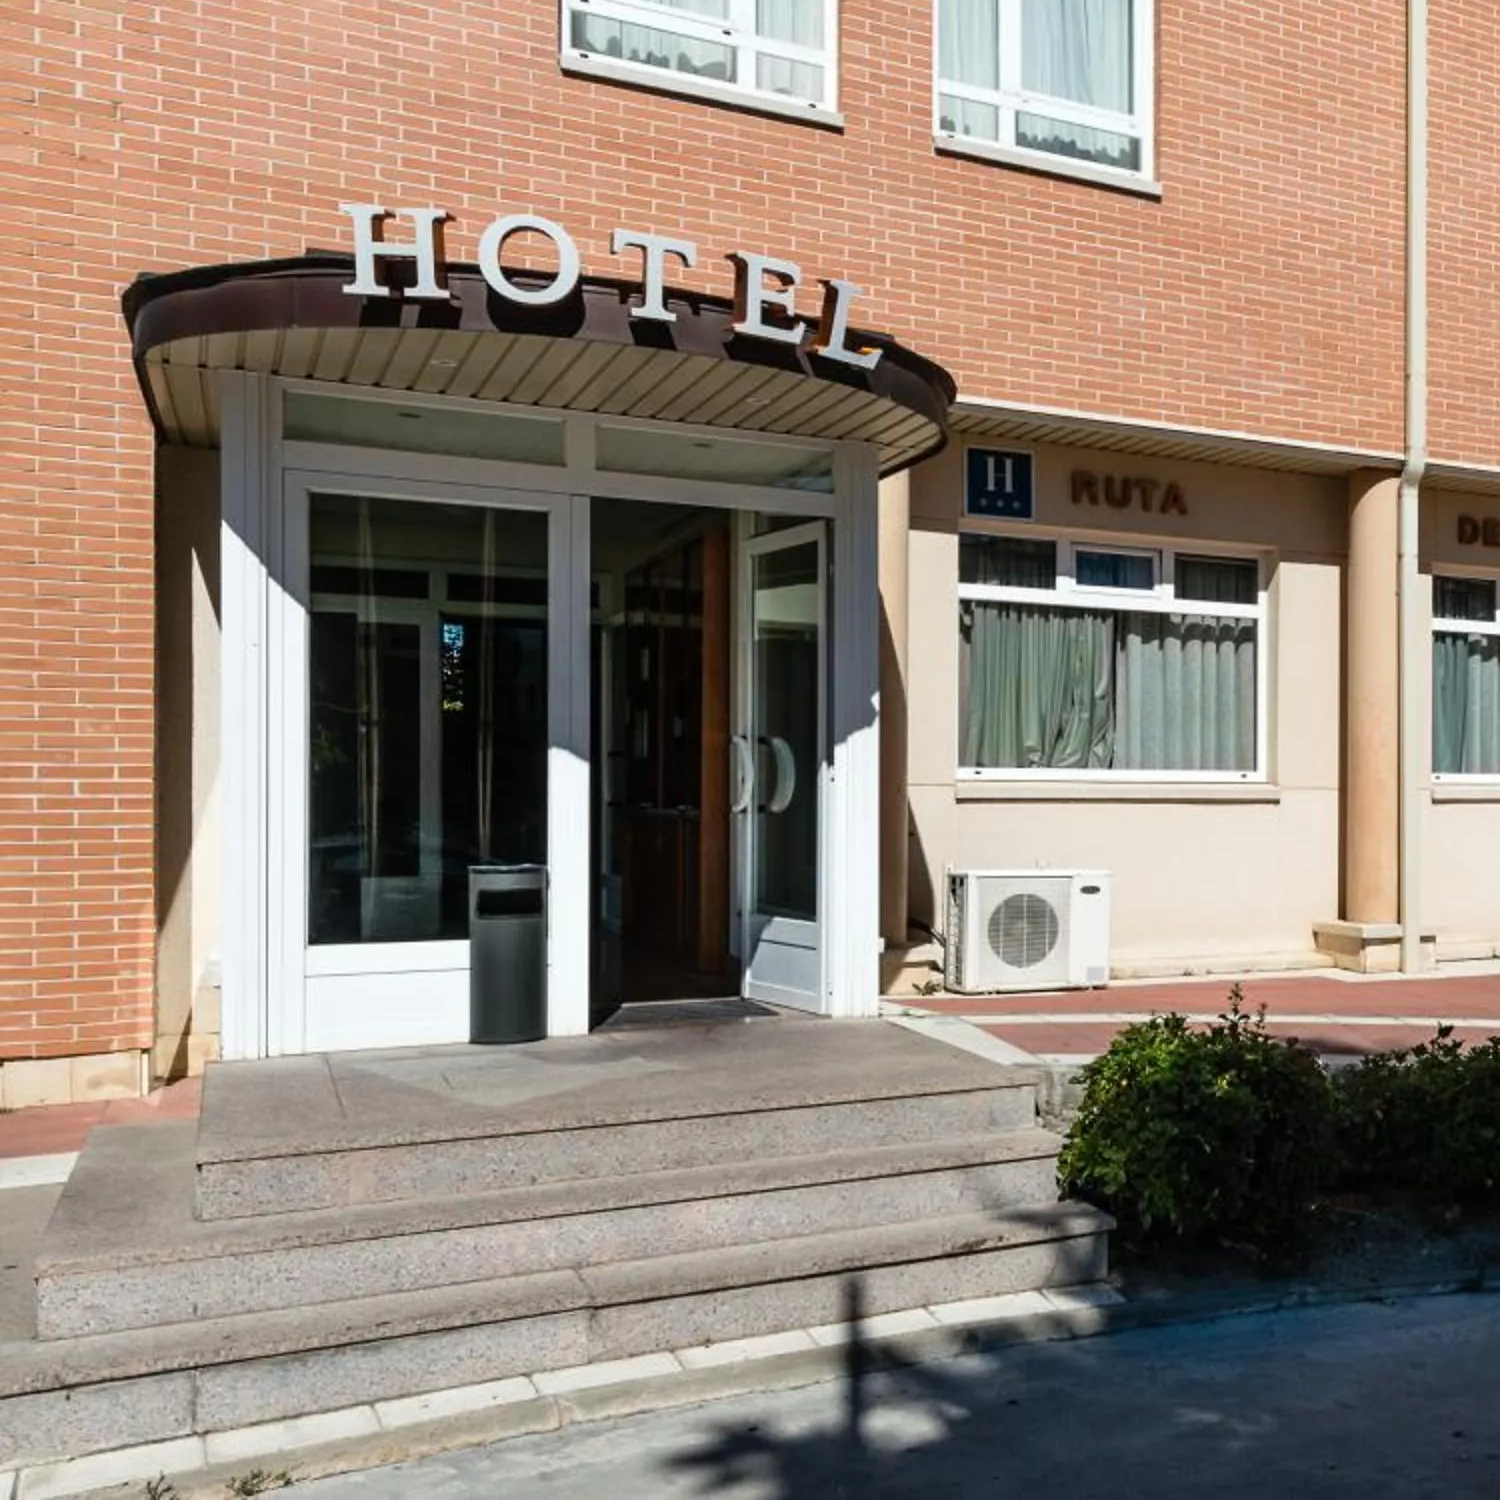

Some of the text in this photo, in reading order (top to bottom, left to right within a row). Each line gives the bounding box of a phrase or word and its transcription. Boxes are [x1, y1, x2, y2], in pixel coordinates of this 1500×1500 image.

[339, 202, 885, 369] HOTEL
[986, 455, 1014, 494] H
[1069, 467, 1189, 517] RUTA
